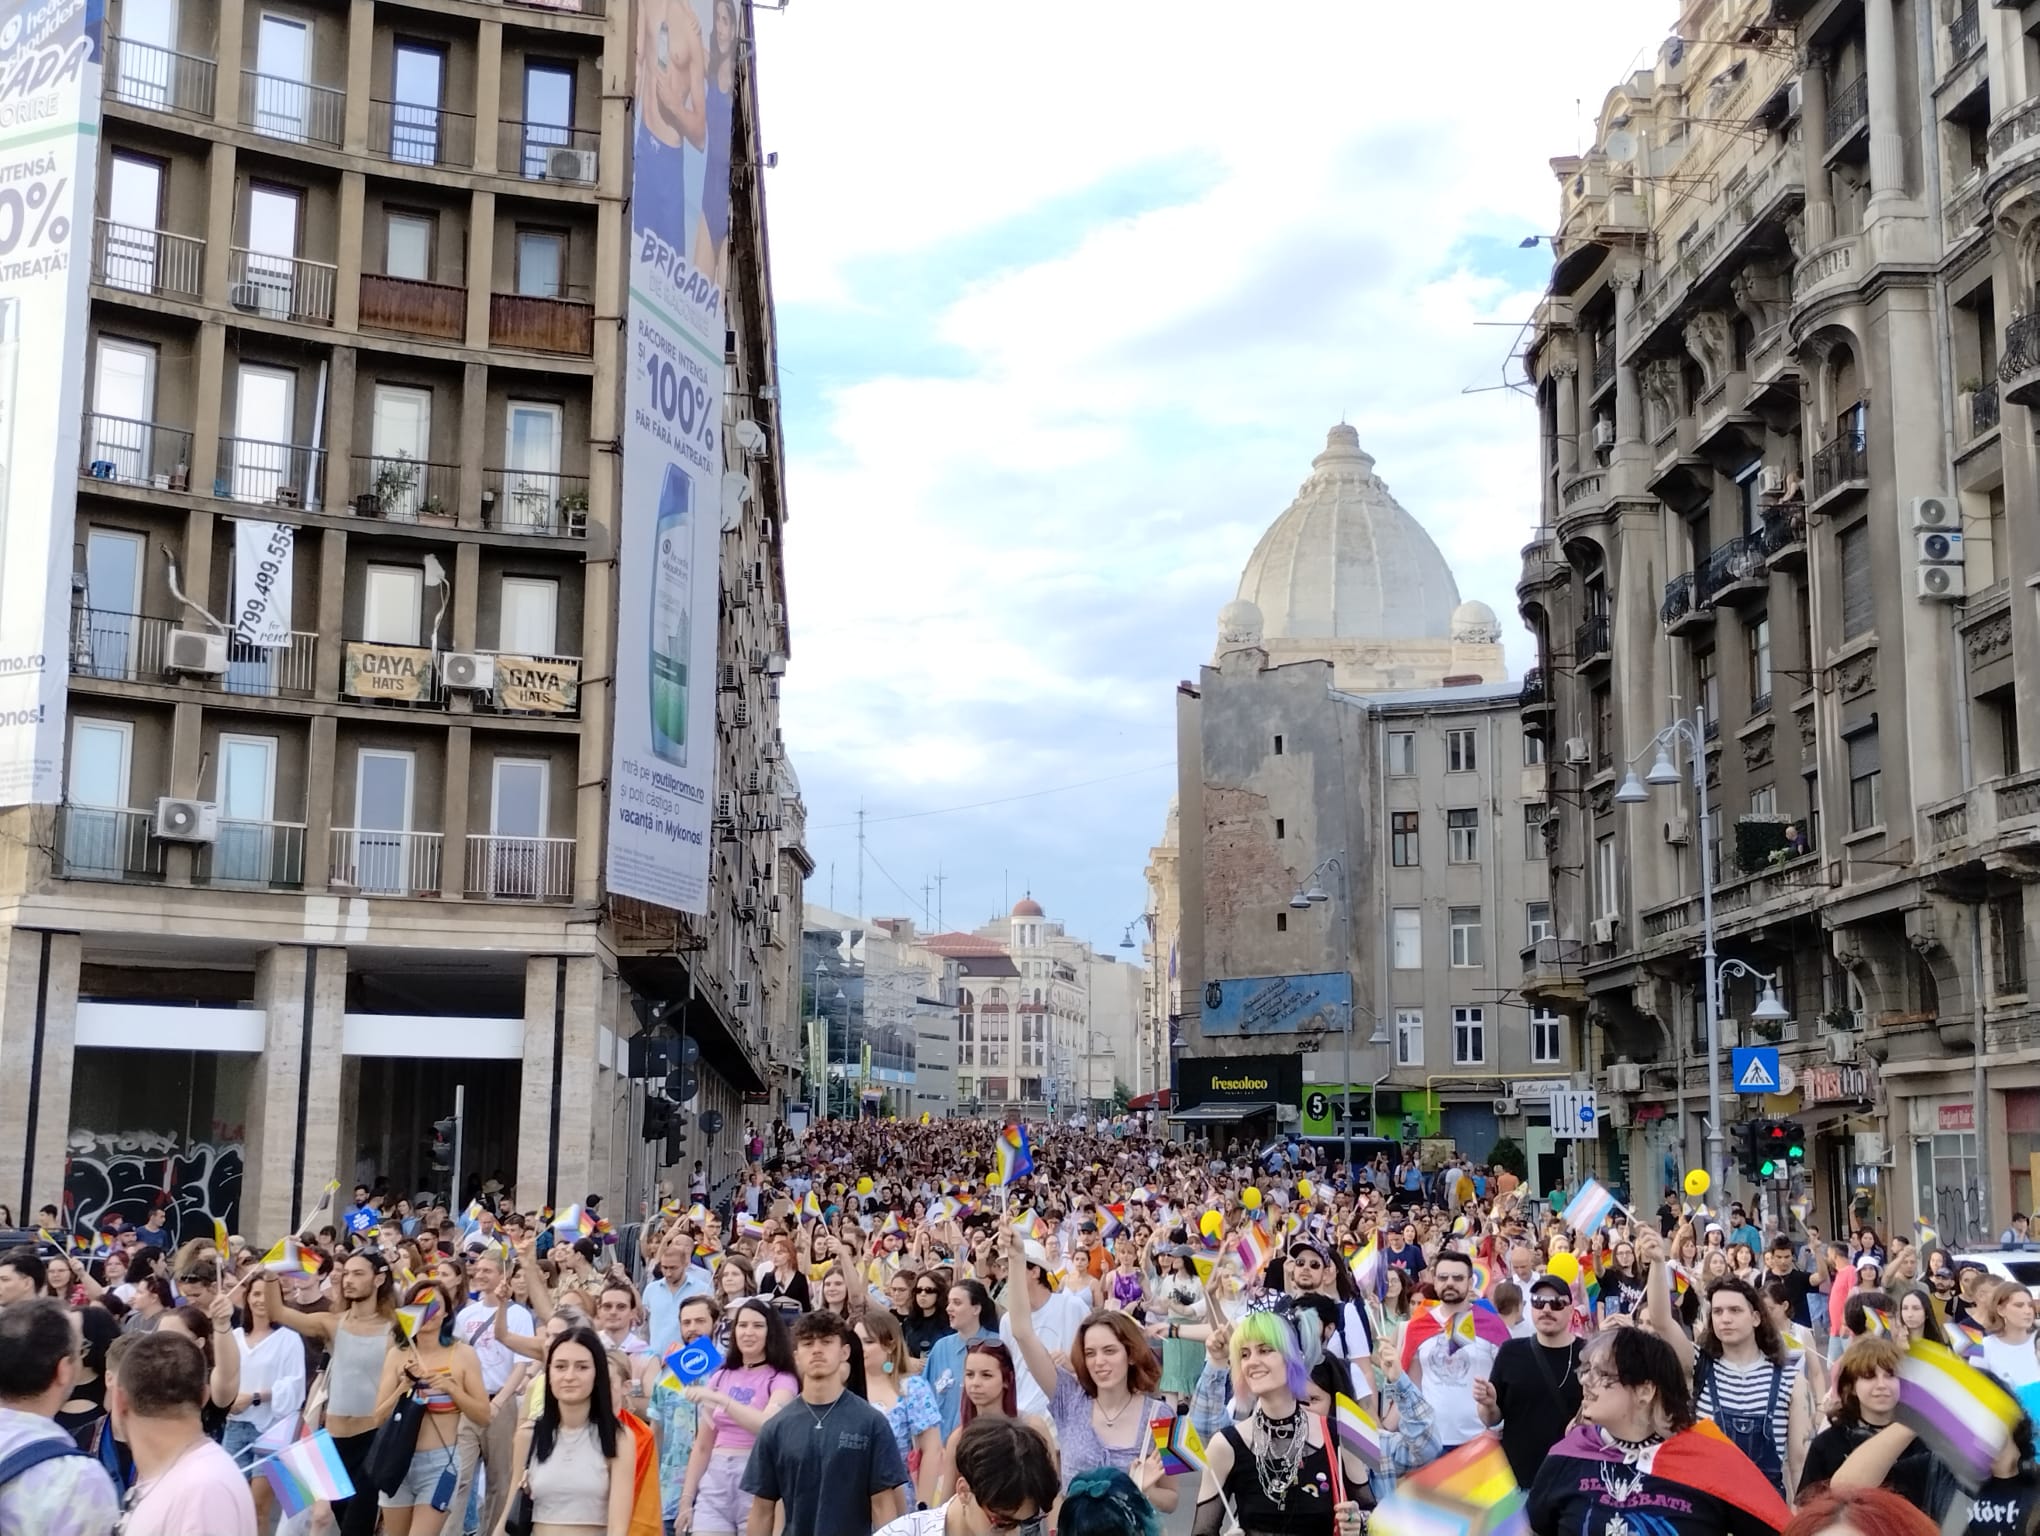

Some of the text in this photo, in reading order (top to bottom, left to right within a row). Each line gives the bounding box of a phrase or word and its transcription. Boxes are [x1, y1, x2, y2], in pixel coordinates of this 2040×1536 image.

[640, 233, 720, 319] BRIGADA
[646, 353, 715, 451] 100%
[260, 631, 289, 643] rent
[362, 653, 417, 678] GAYA
[372, 675, 405, 691] HATS
[510, 668, 561, 692] GAYA
[520, 689, 551, 704] HATS
[1211, 1075, 1268, 1090] frescoloco
[1312, 1095, 1323, 1114] 5
